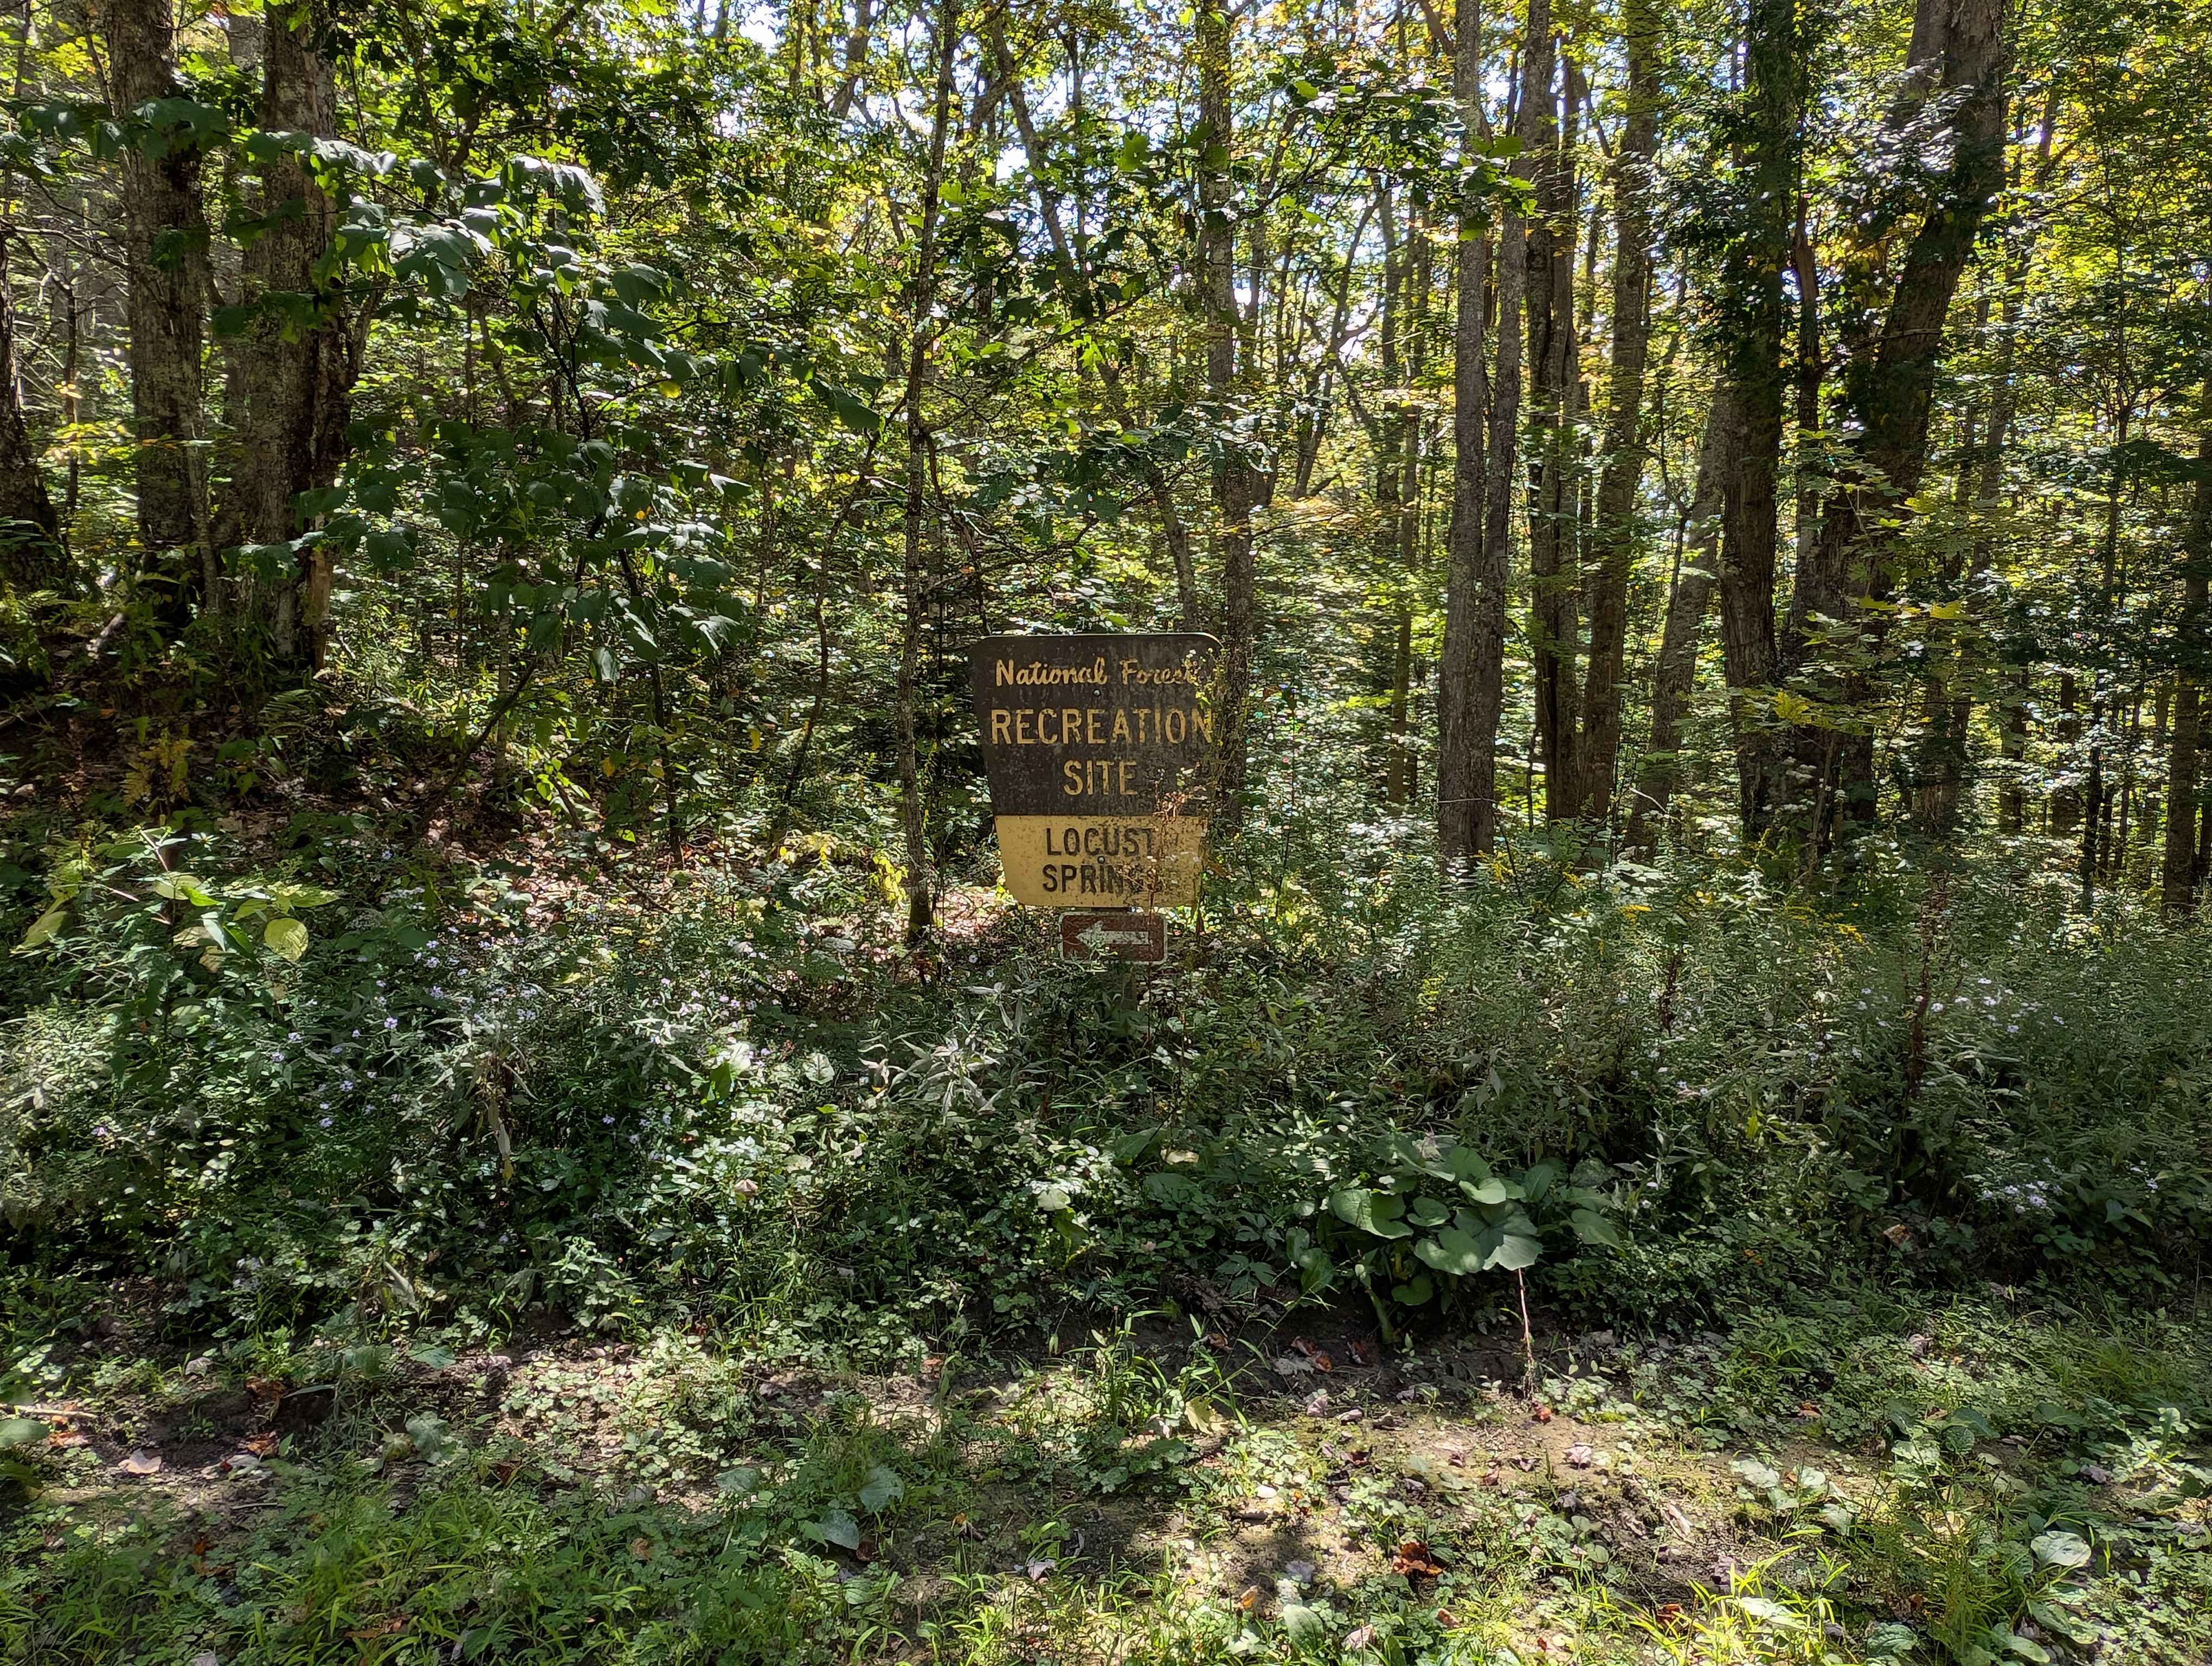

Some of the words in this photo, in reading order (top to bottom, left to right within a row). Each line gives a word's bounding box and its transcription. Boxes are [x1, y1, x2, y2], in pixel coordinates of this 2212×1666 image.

[996, 657, 1108, 687] National
[991, 708, 1212, 745] RECREATION
[1063, 760, 1138, 796] SITE
[1045, 827, 1153, 856] LOCUST
